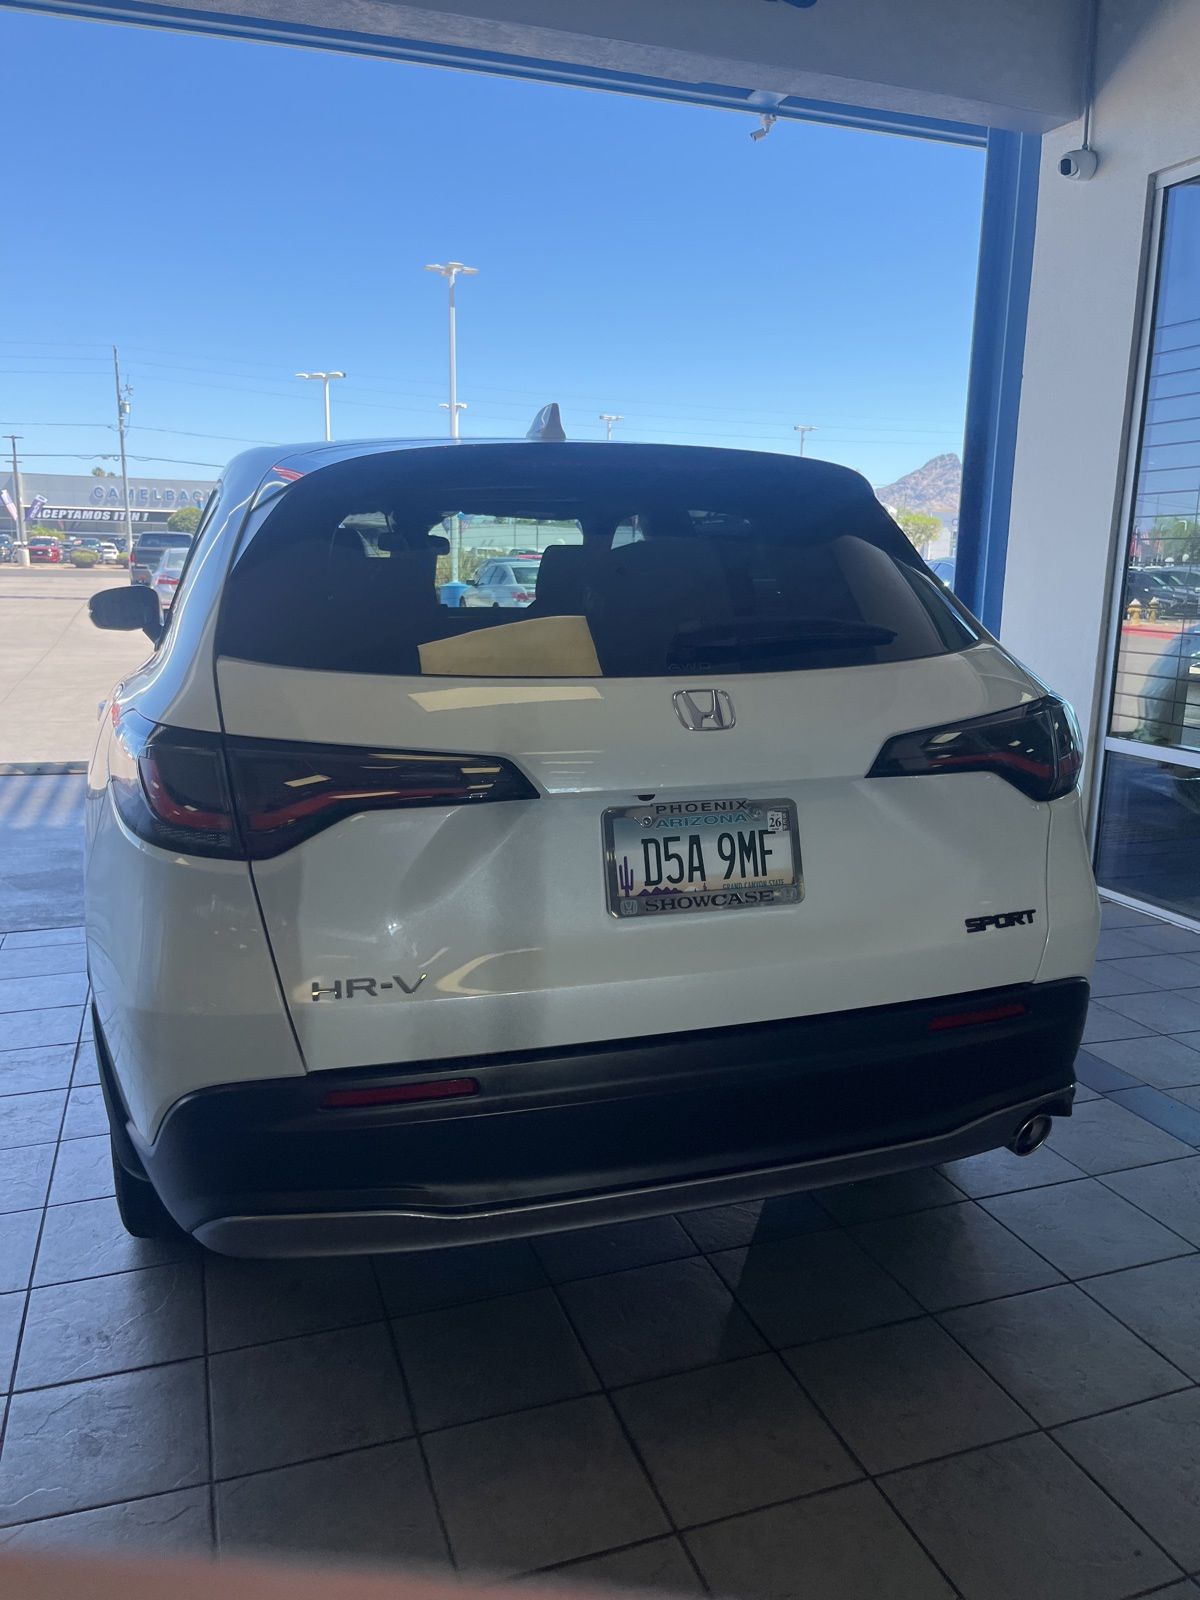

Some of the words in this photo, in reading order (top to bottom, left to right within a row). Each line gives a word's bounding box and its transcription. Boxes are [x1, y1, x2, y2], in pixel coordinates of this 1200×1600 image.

[93, 485, 212, 502] CAMELBAC
[114, 511, 140, 521] ITN
[656, 800, 750, 814] PHOENIX
[655, 814, 748, 829] ARIZONA
[769, 817, 782, 828] 26
[641, 834, 707, 886] D5A
[717, 829, 776, 880] 9MF
[645, 890, 775, 912] SHOWCASE
[965, 909, 1036, 933] SPORT
[312, 973, 427, 1001] HR-V
